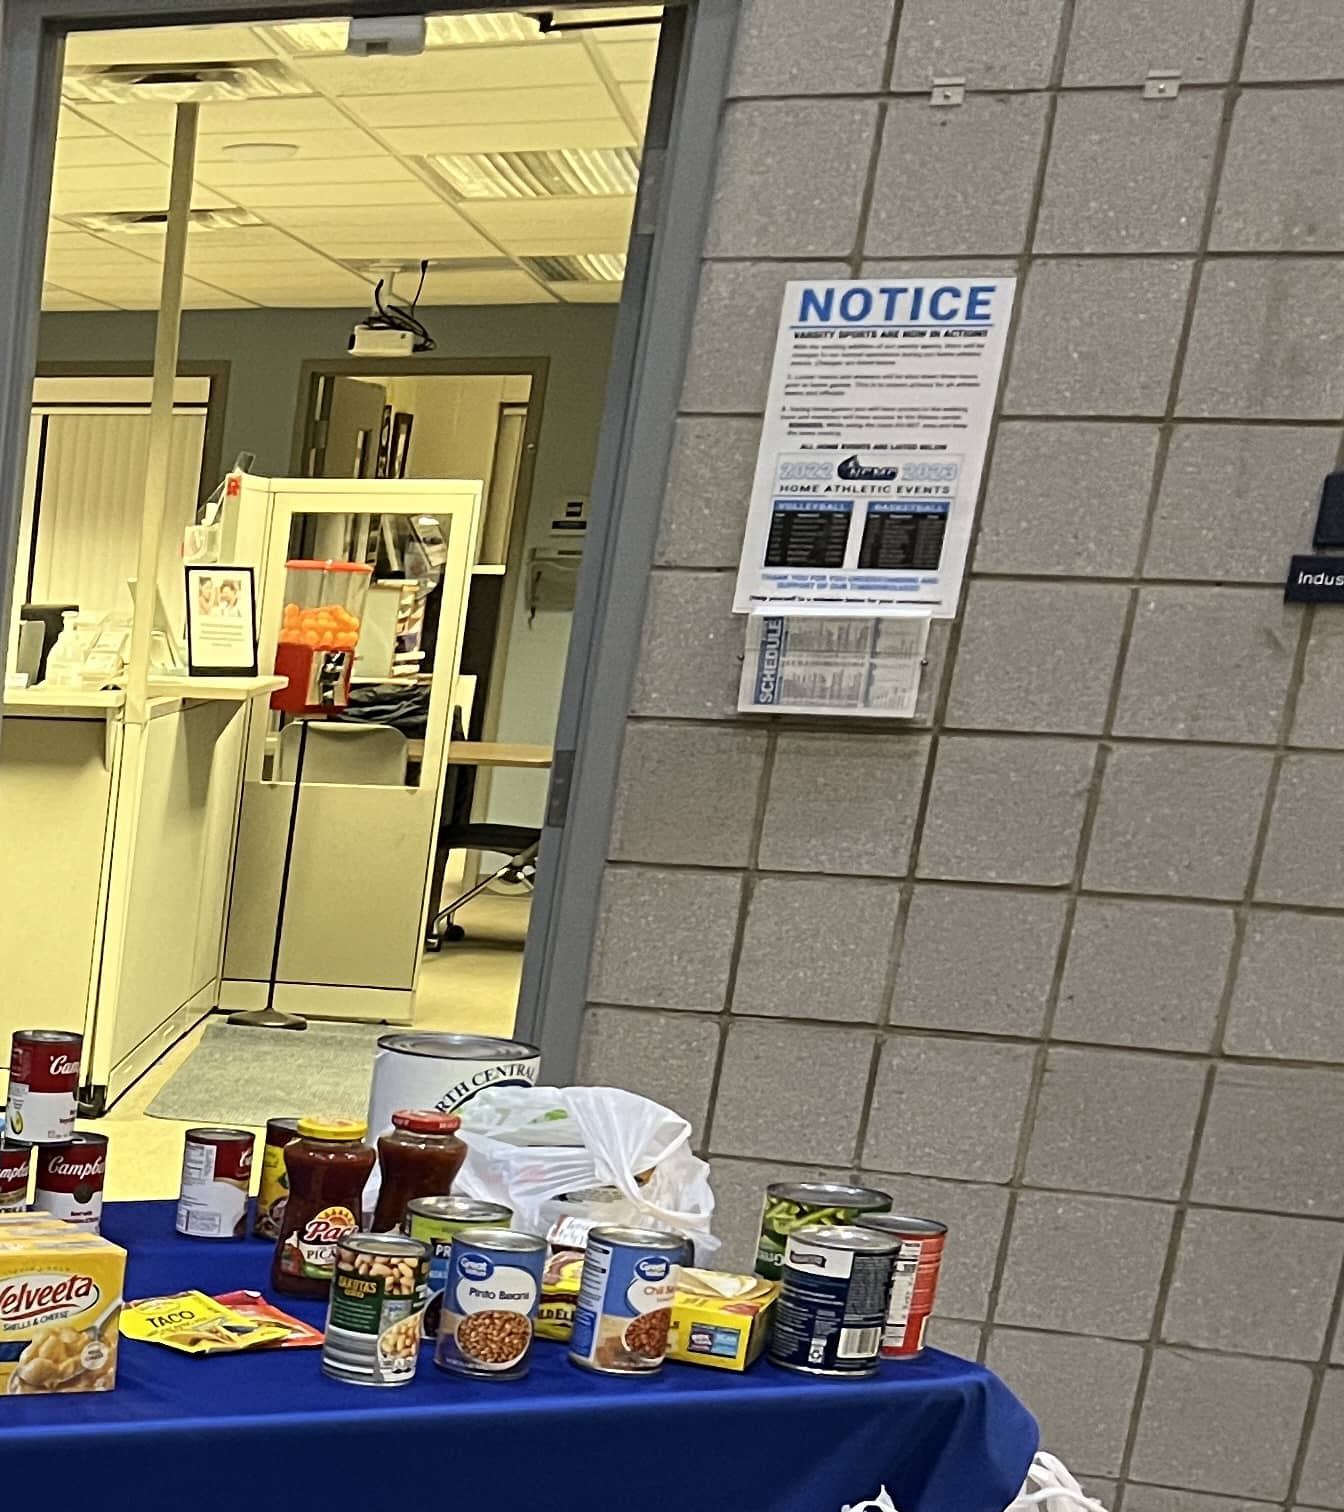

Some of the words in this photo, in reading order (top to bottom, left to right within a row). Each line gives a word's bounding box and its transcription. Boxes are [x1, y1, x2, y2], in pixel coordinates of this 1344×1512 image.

[798, 286, 997, 323] NOTICE
[779, 462, 834, 481] 2022
[900, 463, 958, 481] 2023
[779, 485, 819, 493] HOME
[823, 485, 891, 494] ATHLETIC
[896, 485, 951, 494] EVENTS
[778, 502, 846, 511] VOLLEYBALL
[873, 503, 944, 512] BASKETBALL
[759, 618, 783, 703] SCHEDULE
[471, 1063, 537, 1088] CENTRAL
[469, 1287, 495, 1300] Pinto
[498, 1291, 530, 1300] Beans
[2, 1320, 32, 1332] SHELLS
[32, 1318, 39, 1327] &
[39, 1310, 70, 1324] CHEESE
[148, 1309, 195, 1328] TACO
